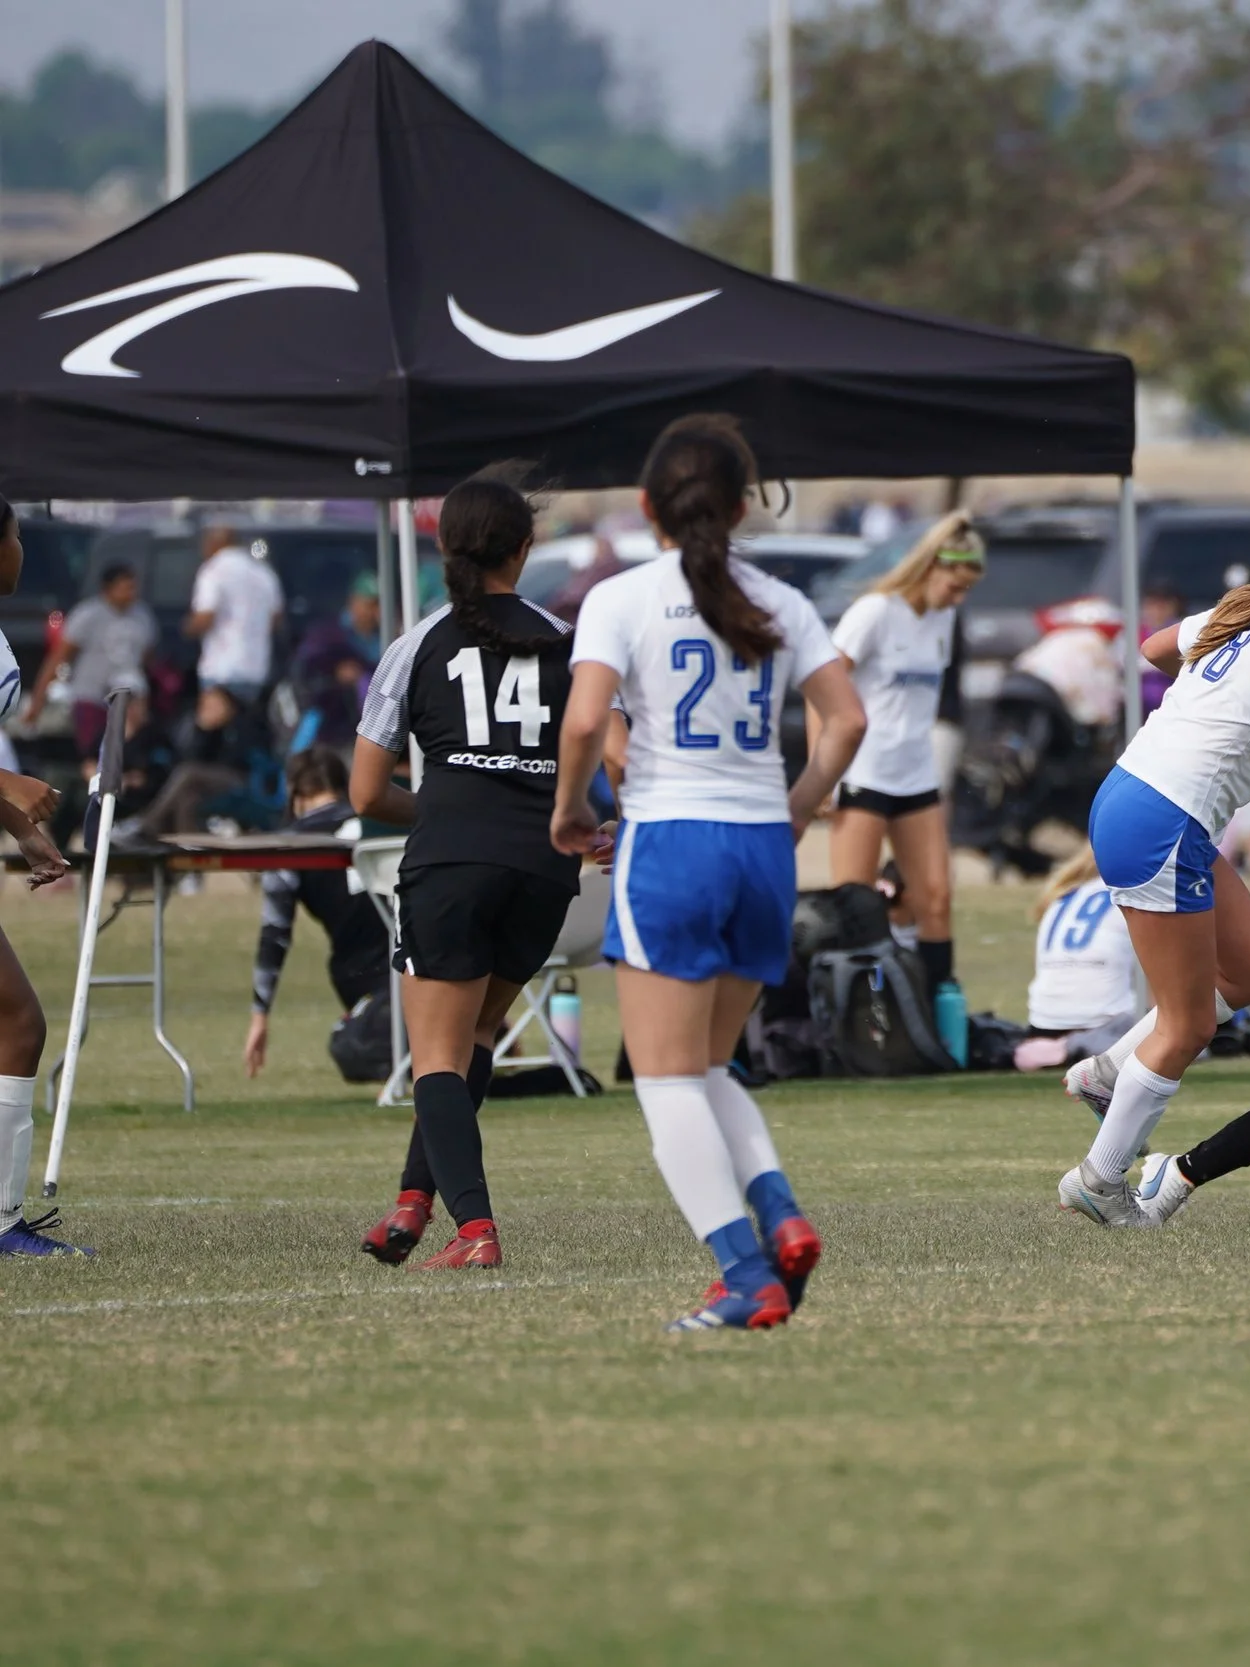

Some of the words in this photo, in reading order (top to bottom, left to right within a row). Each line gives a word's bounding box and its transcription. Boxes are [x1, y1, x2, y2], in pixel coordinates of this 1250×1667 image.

[665, 606, 697, 619] LOS
[446, 646, 551, 747] 14
[671, 639, 774, 749] 23
[1044, 887, 1113, 952] 19
